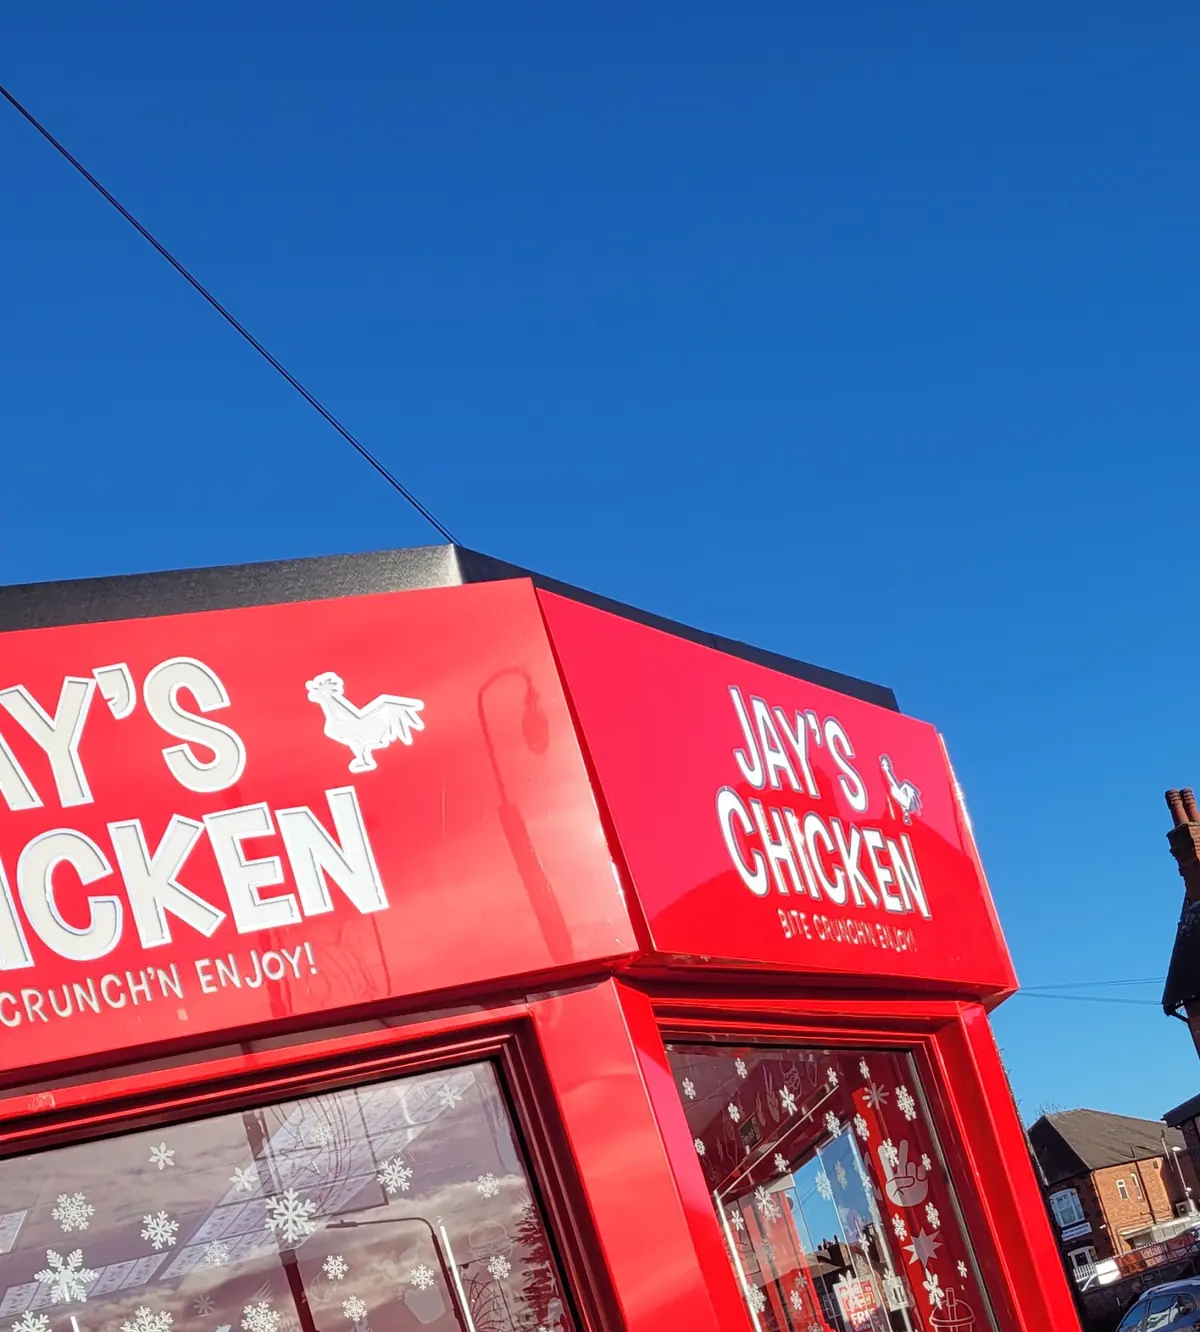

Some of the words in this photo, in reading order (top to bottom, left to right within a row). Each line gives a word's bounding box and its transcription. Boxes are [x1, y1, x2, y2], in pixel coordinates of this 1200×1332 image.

[728, 685, 868, 812] JAY'S
[716, 786, 932, 921] CHICKEN
[777, 908, 812, 939] BITE
[813, 913, 877, 947] CRUNCH'N
[0, 963, 184, 1027] CRUNCH'N
[194, 942, 319, 994] ENJOY!
